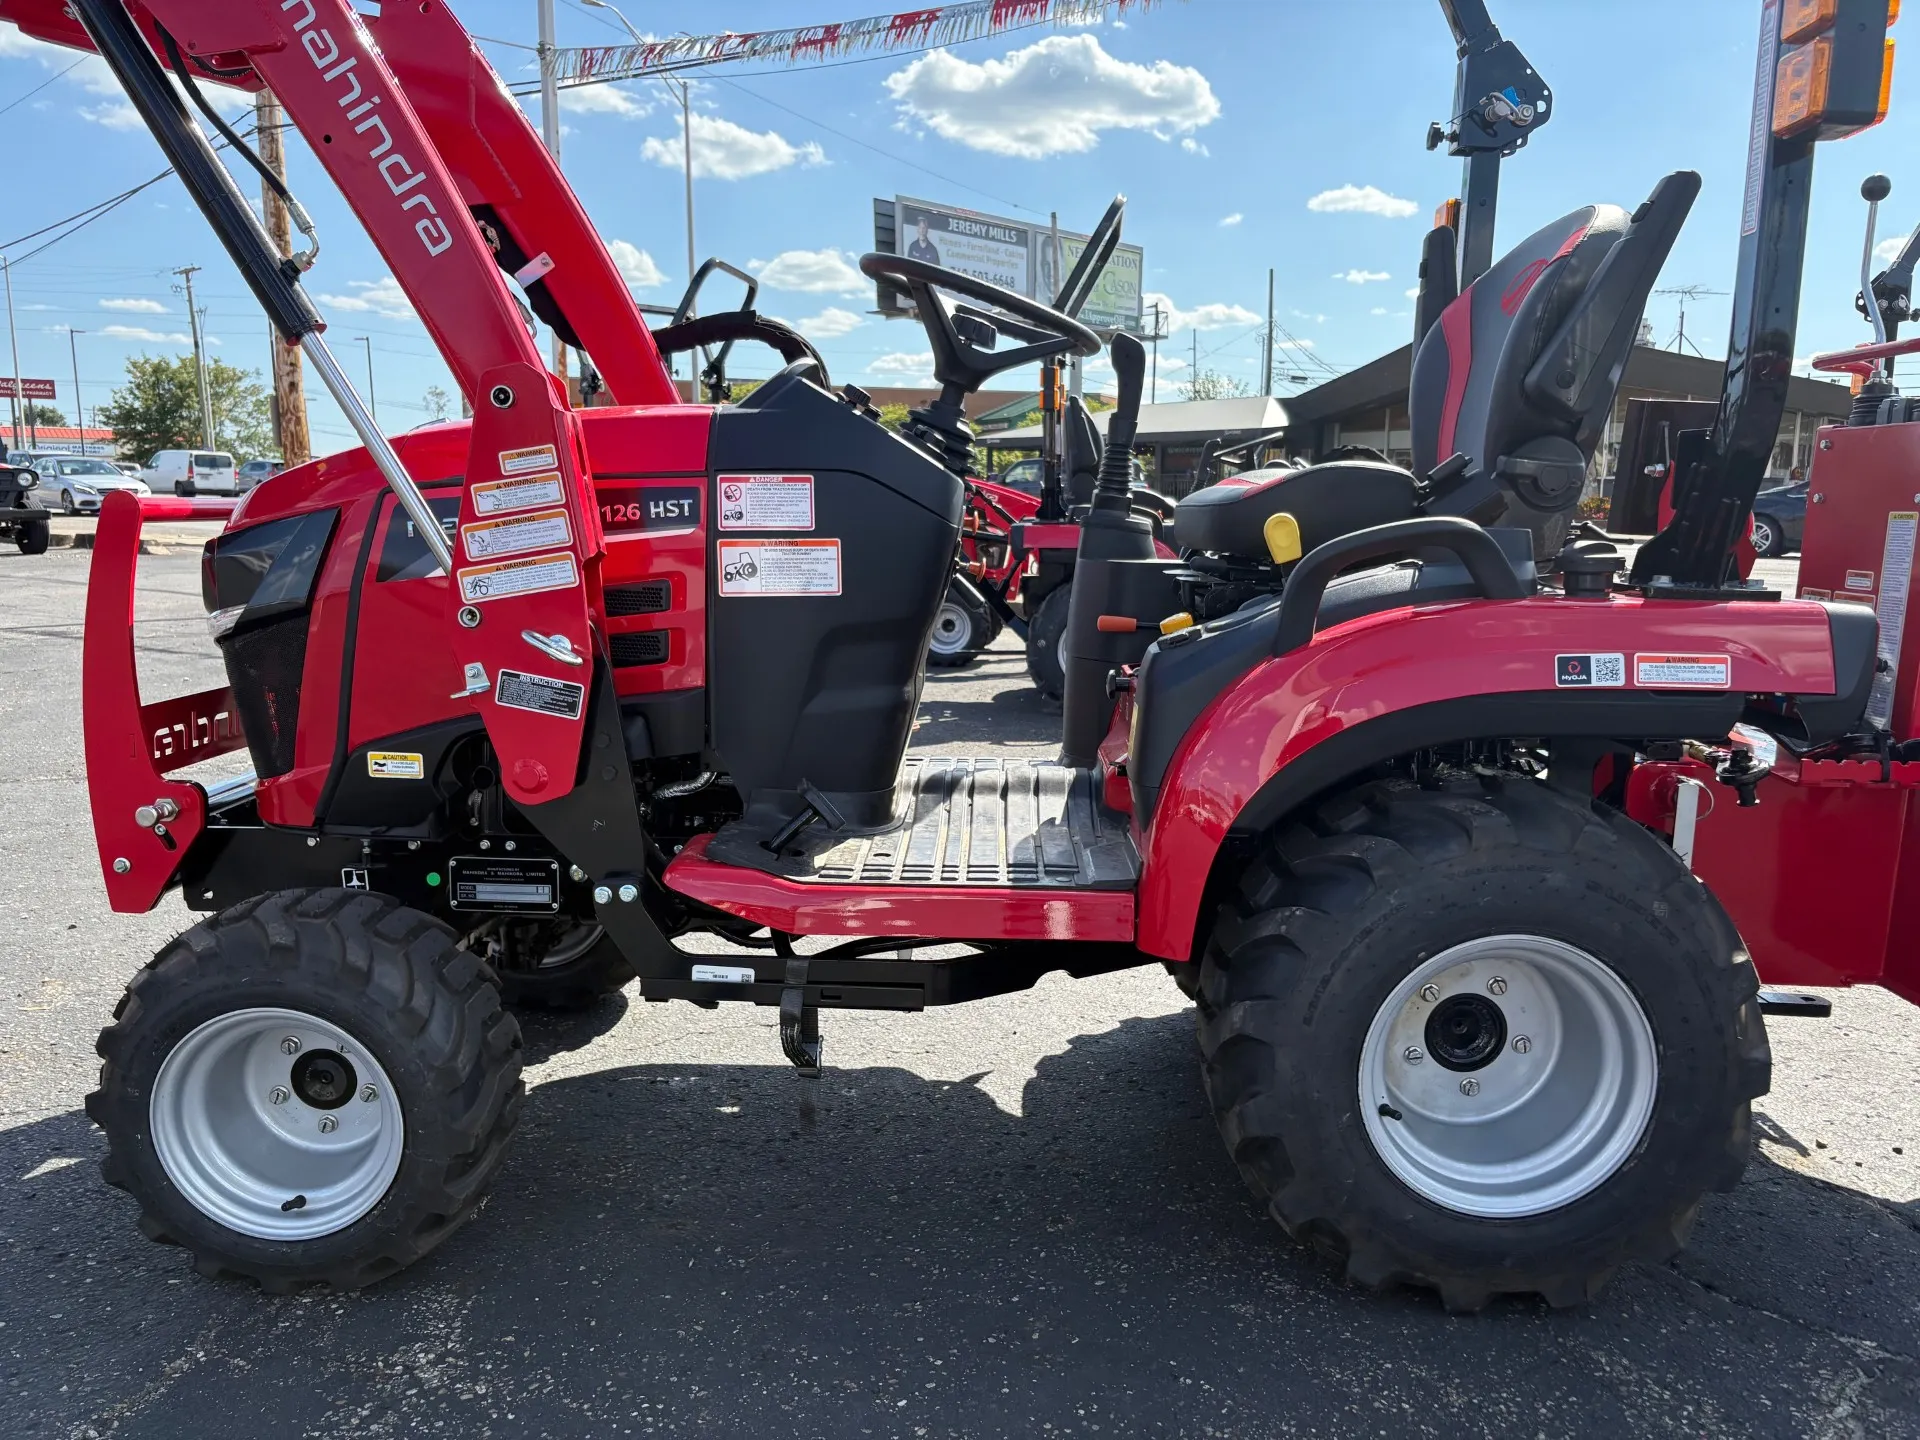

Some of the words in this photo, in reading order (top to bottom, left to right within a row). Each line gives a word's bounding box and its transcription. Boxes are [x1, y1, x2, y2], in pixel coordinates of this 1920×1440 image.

[947, 218, 988, 237] JEREMY
[989, 226, 1017, 243] MILLS
[946, 249, 985, 264] Commercial
[985, 255, 1019, 270] Properties
[1067, 244, 1083, 259] NE
[1107, 254, 1138, 270] ATION
[0, 380, 52, 391] algeens
[515, 448, 546, 458] WARNING
[503, 477, 537, 488] WARNING
[598, 503, 640, 522] 126
[649, 499, 693, 518] HST
[501, 515, 536, 527] WARNING
[502, 559, 537, 570] WARNING
[519, 674, 564, 688] INSTRUCTION
